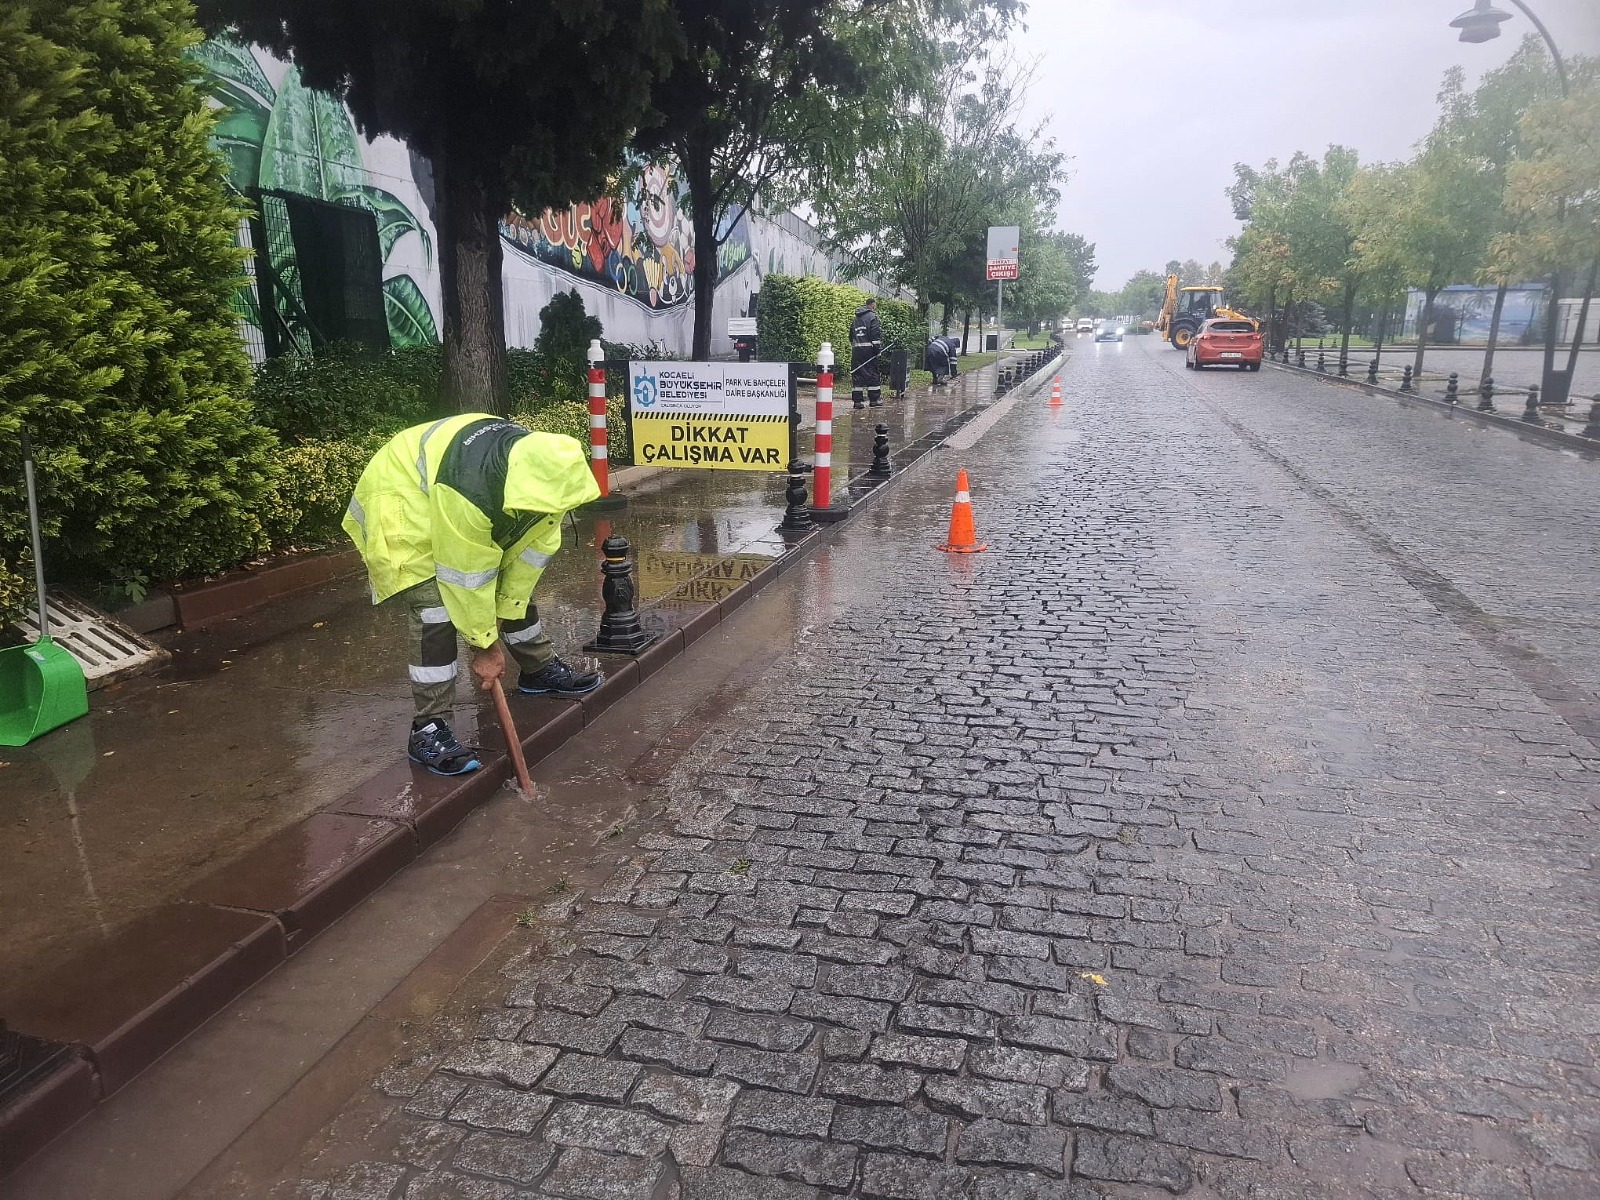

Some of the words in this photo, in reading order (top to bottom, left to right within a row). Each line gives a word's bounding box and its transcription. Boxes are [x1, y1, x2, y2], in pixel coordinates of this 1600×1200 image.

[659, 380, 723, 391] BÜYÜKŞEHİR
[725, 378, 742, 387] PARK
[743, 379, 752, 387] VE
[753, 379, 786, 389] BAHÇELER
[660, 390, 708, 399] BELEDİYESİ
[725, 388, 746, 398] DAİRE
[747, 389, 787, 399] BAŞKANLIĞI
[671, 422, 749, 443] DİKKAT
[642, 443, 735, 465] ÇALIŞMA
[738, 447, 780, 464] VAR
